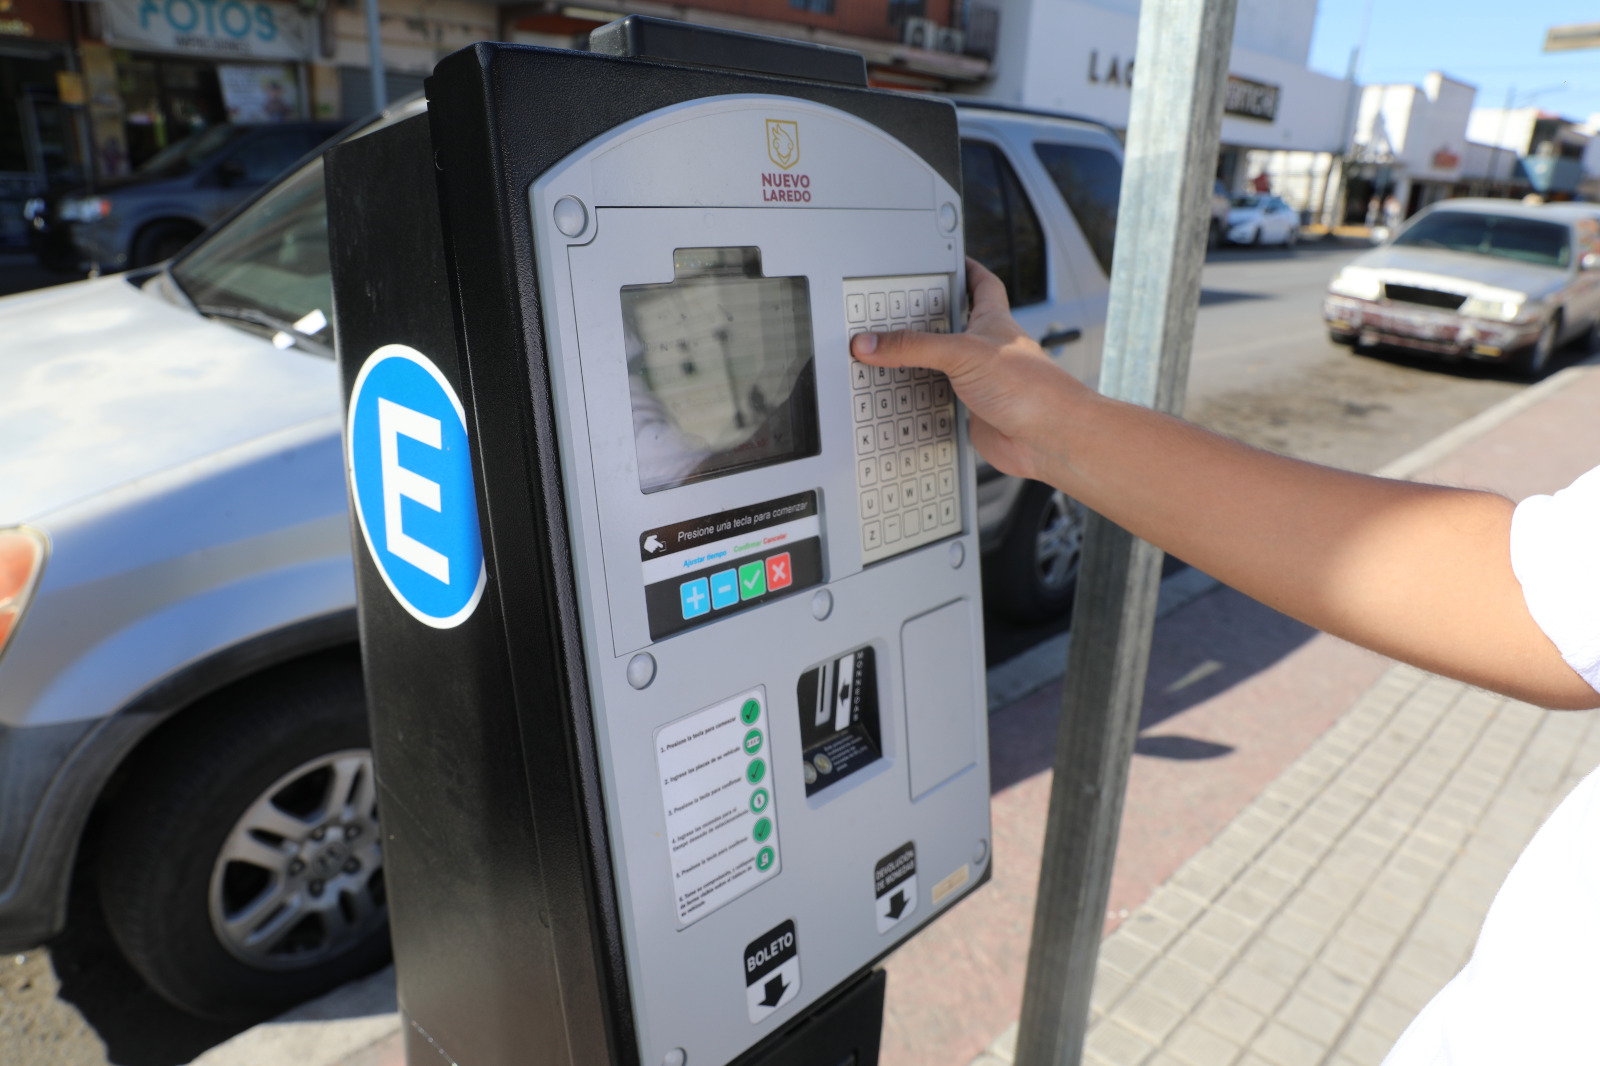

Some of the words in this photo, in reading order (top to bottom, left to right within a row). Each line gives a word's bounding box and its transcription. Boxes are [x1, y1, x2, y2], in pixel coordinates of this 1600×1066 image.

[761, 172, 810, 189] NUEVO
[763, 189, 812, 203] LAREDO
[875, 302, 881, 312] 2
[895, 300, 901, 310] 3
[915, 298, 920, 308] 4
[933, 296, 939, 306] 5
[858, 370, 865, 380] A
[879, 366, 885, 377] B
[860, 402, 866, 413] F
[880, 398, 888, 409] G
[900, 395, 908, 405] H
[862, 435, 870, 445] K
[883, 430, 889, 441] L
[902, 426, 910, 436] M
[921, 422, 928, 433] N
[864, 467, 871, 478] P
[885, 461, 892, 472] Q
[904, 457, 912, 468] R
[923, 452, 930, 463] S
[942, 448, 947, 458] T
[378, 396, 450, 586] E
[867, 499, 873, 509] U
[887, 493, 894, 503] V
[905, 487, 914, 498] W
[925, 482, 931, 493] X
[943, 477, 949, 487] Y
[677, 525, 715, 542] Presione
[716, 521, 732, 532] una
[733, 515, 752, 528] tecla
[753, 511, 771, 526] para
[772, 501, 809, 518] comenzar
[869, 530, 876, 541] Z
[683, 555, 706, 568] Ajustar
[706, 550, 727, 562] tiempo
[733, 540, 762, 553] Confirmar
[762, 533, 788, 545] Cancelar
[746, 931, 794, 973] BOLETO
